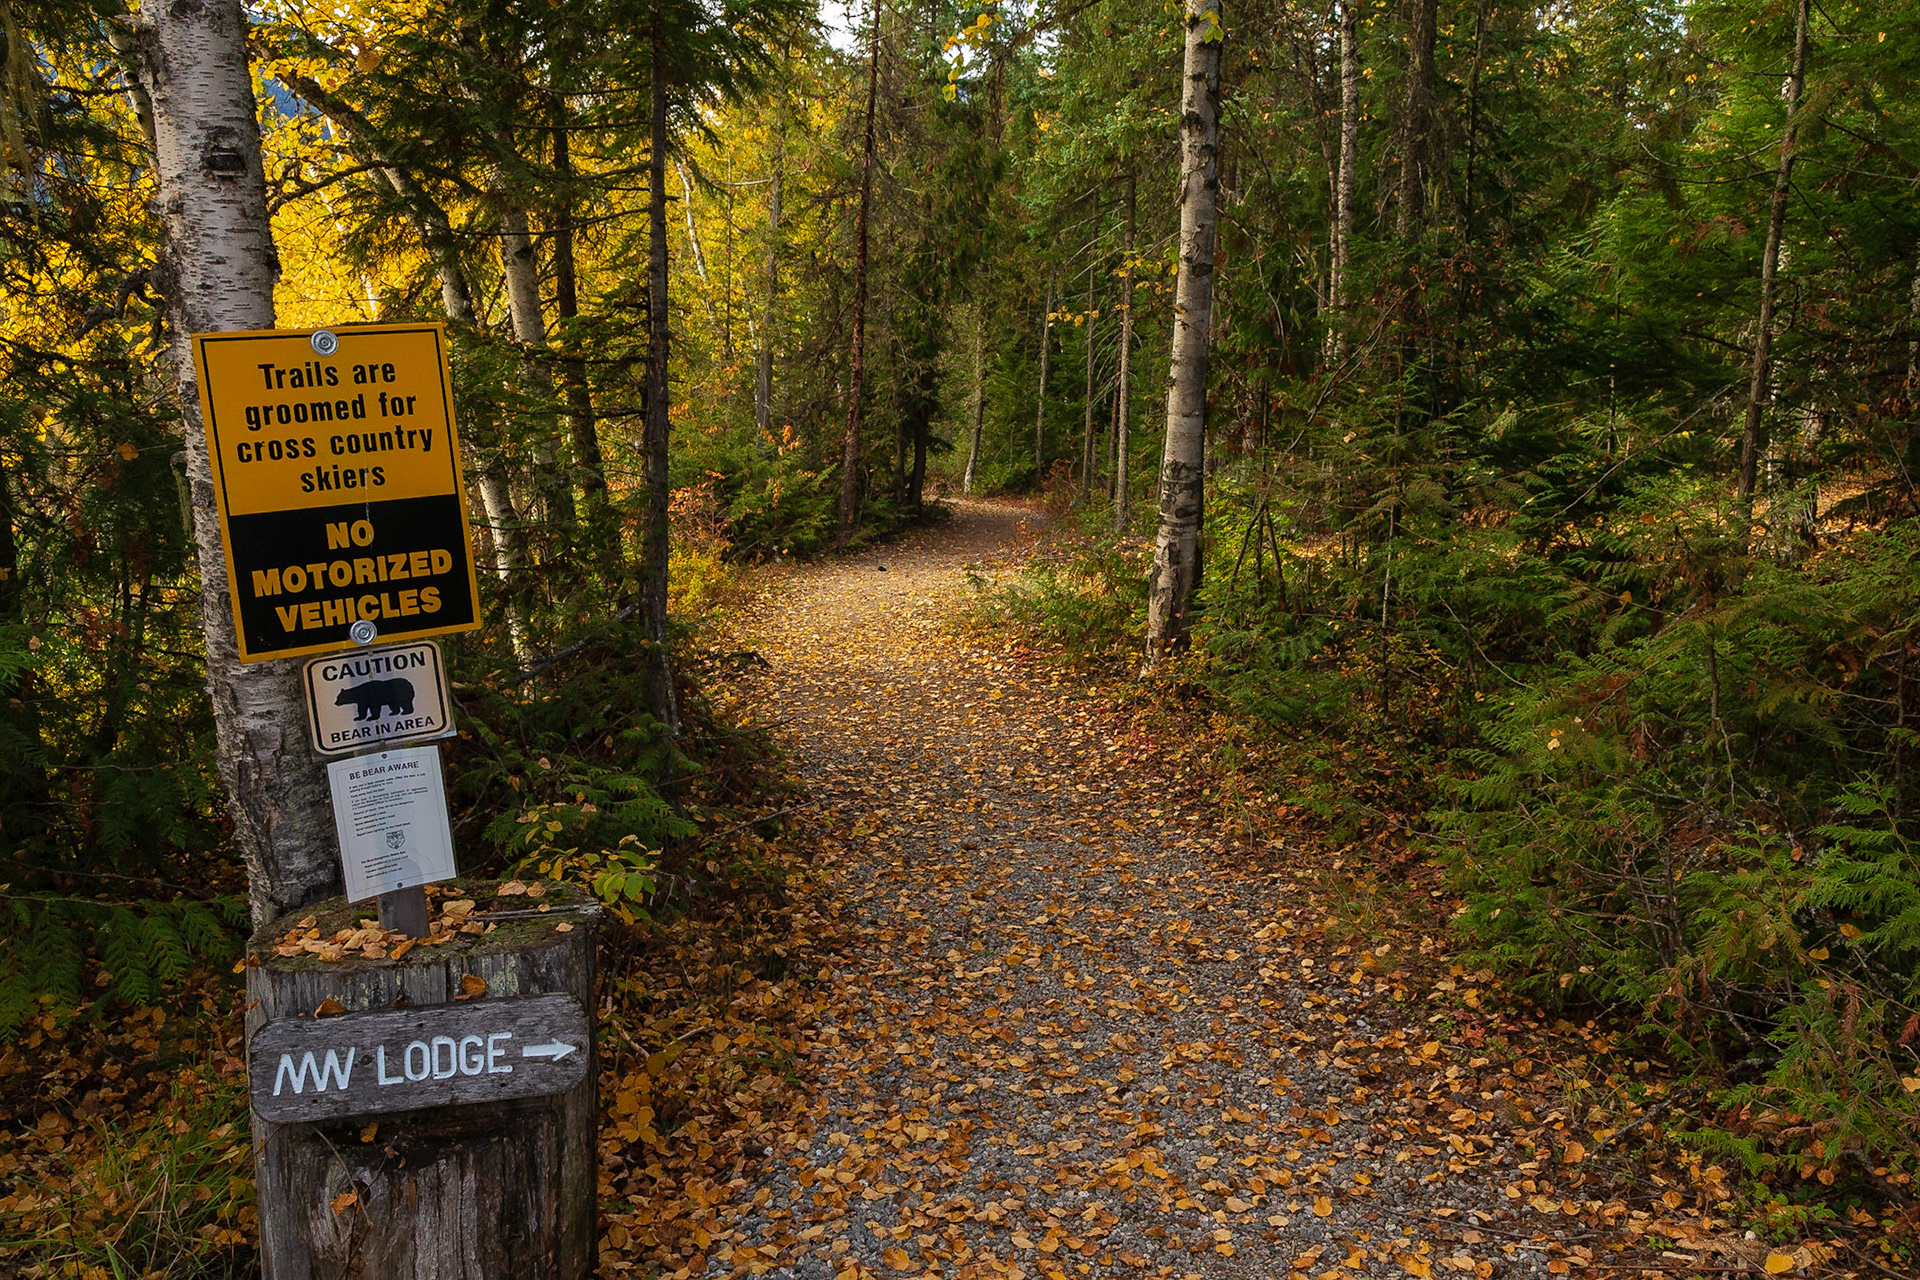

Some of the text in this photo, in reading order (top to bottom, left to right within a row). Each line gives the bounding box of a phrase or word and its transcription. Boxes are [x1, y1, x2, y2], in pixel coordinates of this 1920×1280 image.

[258, 361, 396, 390] Trails are
[245, 392, 417, 432] groomed for
[237, 425, 433, 463] cross country
[300, 465, 386, 493] skiers
[325, 519, 375, 550] NO
[251, 549, 453, 598] MOTORIZED
[275, 586, 442, 633] VEHICLES
[322, 651, 426, 682] CAUTION
[330, 716, 435, 743] BEAR IN AREA
[349, 771, 361, 781] BE
[362, 766, 386, 778] BEAR
[387, 761, 420, 772] AWARE
[376, 1031, 514, 1086] LODGE
